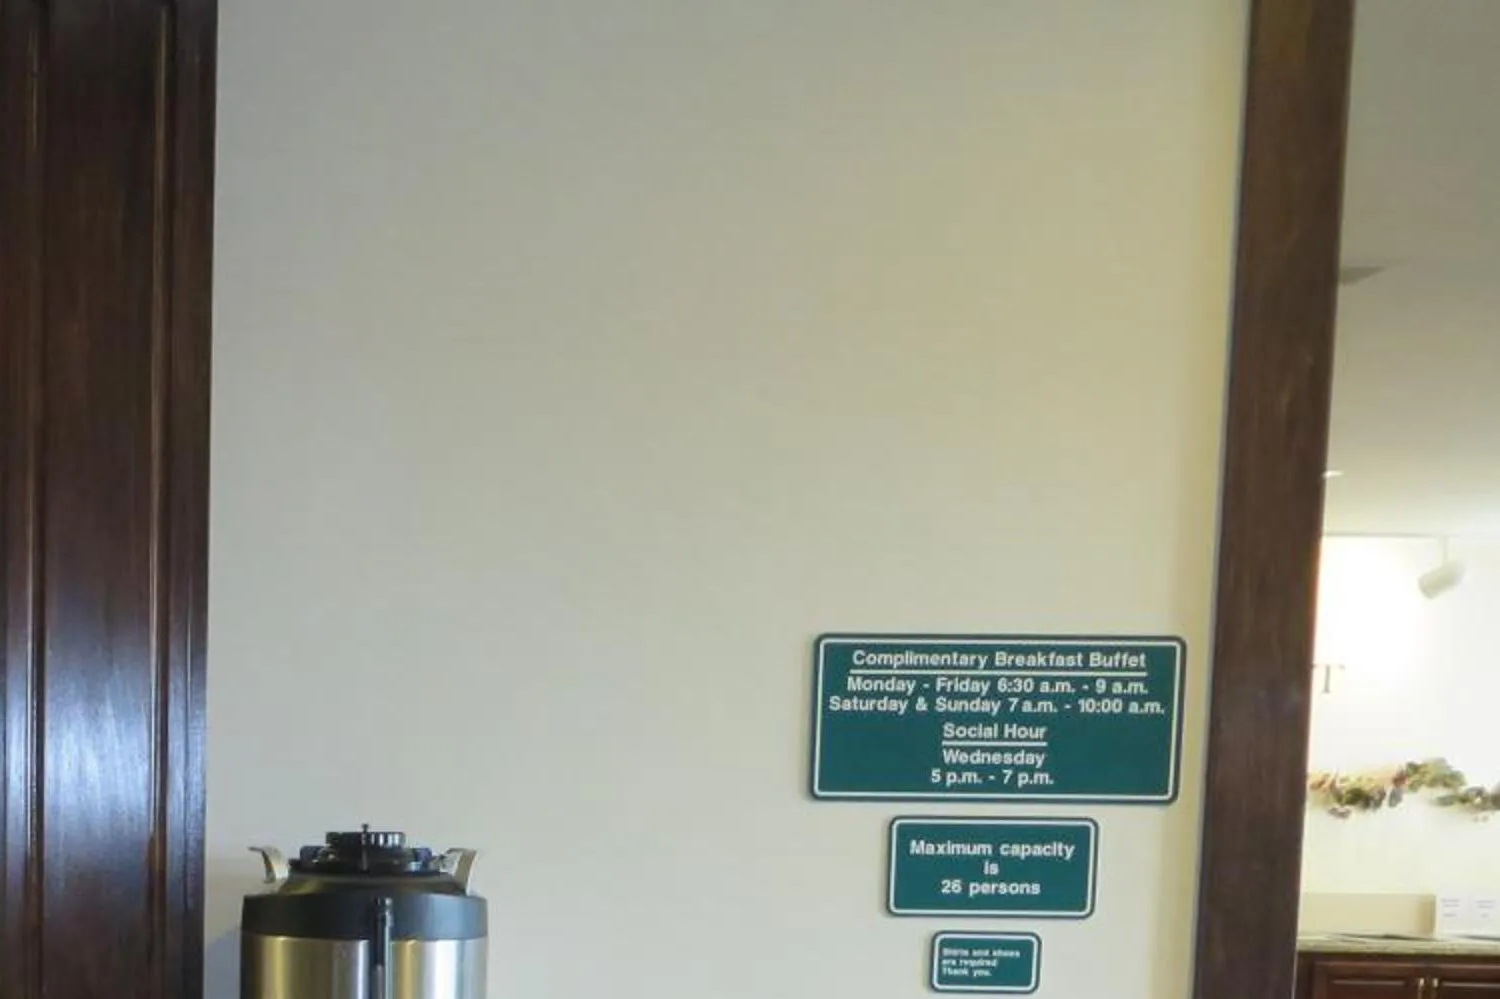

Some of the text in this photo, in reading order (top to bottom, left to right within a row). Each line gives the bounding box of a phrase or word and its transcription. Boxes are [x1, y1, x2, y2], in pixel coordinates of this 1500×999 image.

[852, 649, 1147, 669] Complimentary Breakfast Buffet
[847, 675, 916, 696] Monday
[935, 676, 991, 696] Friday
[997, 677, 1034, 693] 6:30
[1039, 679, 1077, 694] a.m.
[1095, 678, 1107, 694] 9
[1111, 679, 1149, 695] a.m.
[828, 695, 908, 715] Saturday
[915, 695, 929, 712] &
[934, 696, 1002, 717] Sunday
[1008, 698, 1019, 713] 7
[1021, 699, 1059, 714] a.m.
[1077, 698, 1123, 714] 10:00
[1128, 700, 1166, 716] a.m.
[942, 722, 1047, 739] Social Hour
[942, 748, 1045, 769] Wednesday
[931, 767, 942, 783] 5
[946, 771, 983, 787] p.m.
[1002, 768, 1013, 784] 7
[1017, 770, 1055, 788] p.m.
[909, 839, 1075, 861] Maximum capacity
[983, 860, 999, 876] is
[940, 879, 1041, 898] 26 persons
[941, 966, 969, 977] Thank
